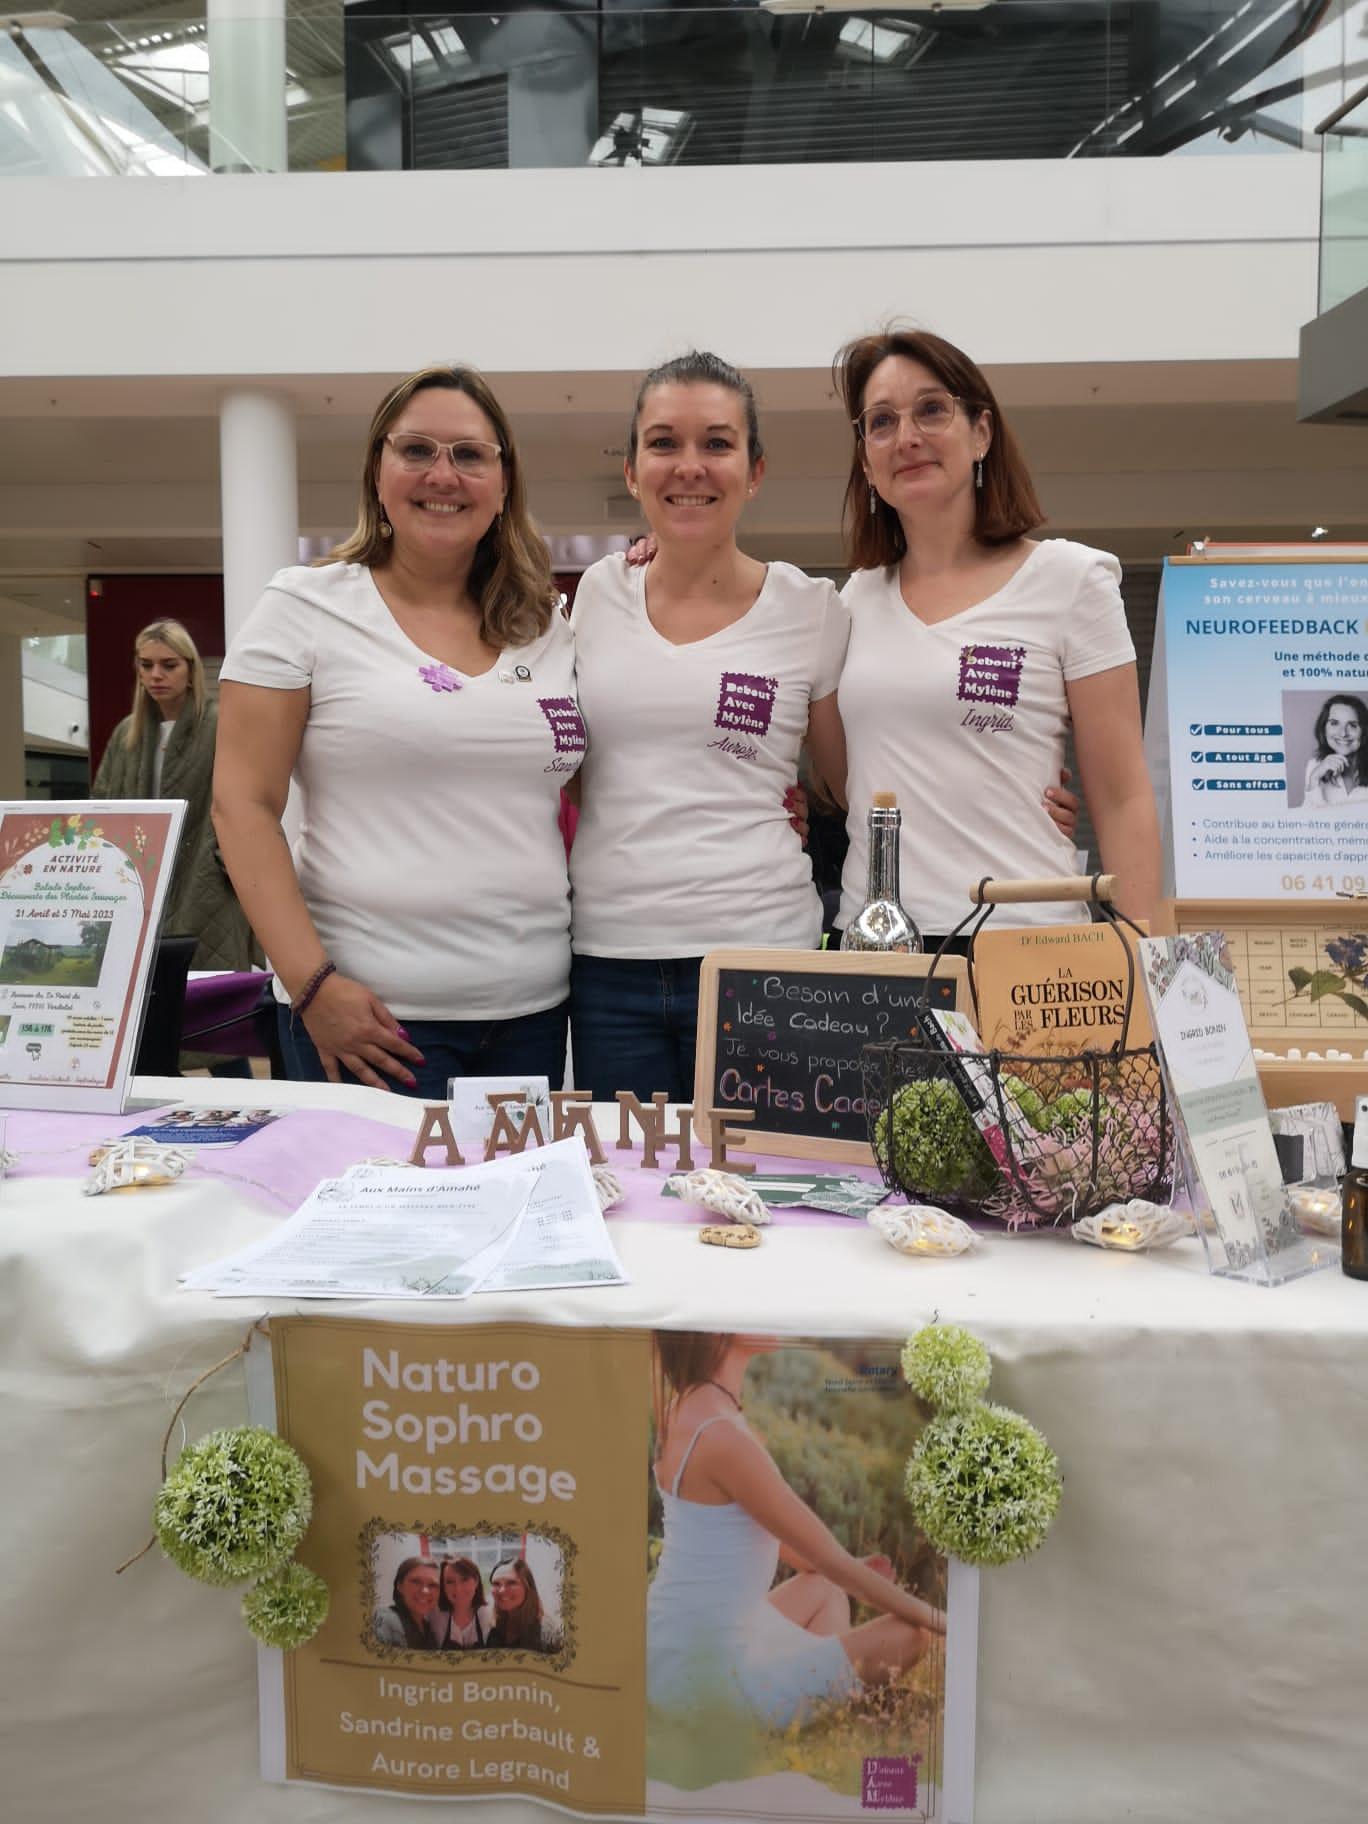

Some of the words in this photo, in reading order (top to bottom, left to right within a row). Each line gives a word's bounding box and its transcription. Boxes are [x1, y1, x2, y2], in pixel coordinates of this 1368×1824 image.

[1210, 577, 1297, 589] Savez-vous
[1185, 619, 1359, 635] NEUROFEEDBACK
[966, 656, 1019, 670] Debout
[1274, 651, 1299, 662] Une
[1302, 650, 1361, 662] méthode
[965, 668, 1000, 681] Avec
[1282, 668, 1295, 678] et
[1299, 667, 1333, 678] 100%
[726, 682, 771, 701] Debout
[964, 682, 1013, 699] Mylène
[724, 696, 756, 711] Avec
[556, 721, 577, 731] Avec
[721, 710, 765, 729] Mylène
[960, 708, 1015, 733] Ingrid
[1215, 726, 1241, 734] Pour
[1245, 726, 1270, 734] tous
[1226, 753, 1250, 761] tout
[1215, 781, 1242, 789] Sans
[1245, 780, 1280, 789] effort
[1202, 819, 1259, 830] Contribue
[1261, 821, 1275, 829] au
[1277, 819, 1330, 829] bien-être
[1203, 835, 1229, 845] Aide
[1204, 850, 1254, 861] Améliore
[1256, 850, 1273, 861] les
[1275, 851, 1330, 864] capacités
[42, 864, 58, 873] EN
[59, 864, 104, 874] NATURE
[1280, 875, 1306, 891] 06
[1312, 875, 1334, 891] 41
[15, 909, 25, 918] 21
[1058, 967, 1073, 979] LA
[763, 976, 850, 1004] Besoin
[1010, 977, 1124, 1006] GUÉRISON
[737, 1000, 776, 1028] Idée
[788, 1011, 870, 1036] Cadeau
[875, 1010, 890, 1035] ?
[1014, 1009, 1032, 1020] PAR
[1040, 1004, 1126, 1029] FLEURS
[723, 1036, 749, 1057] Je
[758, 1046, 800, 1065] vous
[719, 1068, 806, 1113] Cartes
[362, 1347, 541, 1393] Naturo
[361, 1399, 543, 1455] Sophro
[356, 1449, 577, 1504] Massage
[379, 1676, 453, 1707] Ingrid
[463, 1681, 562, 1713] Bonnin,
[339, 1711, 454, 1742] Sandrine
[461, 1719, 575, 1754] Gerbault
[582, 1736, 602, 1760] &
[371, 1752, 461, 1780] Aurore
[469, 1759, 570, 1791] Legrand
